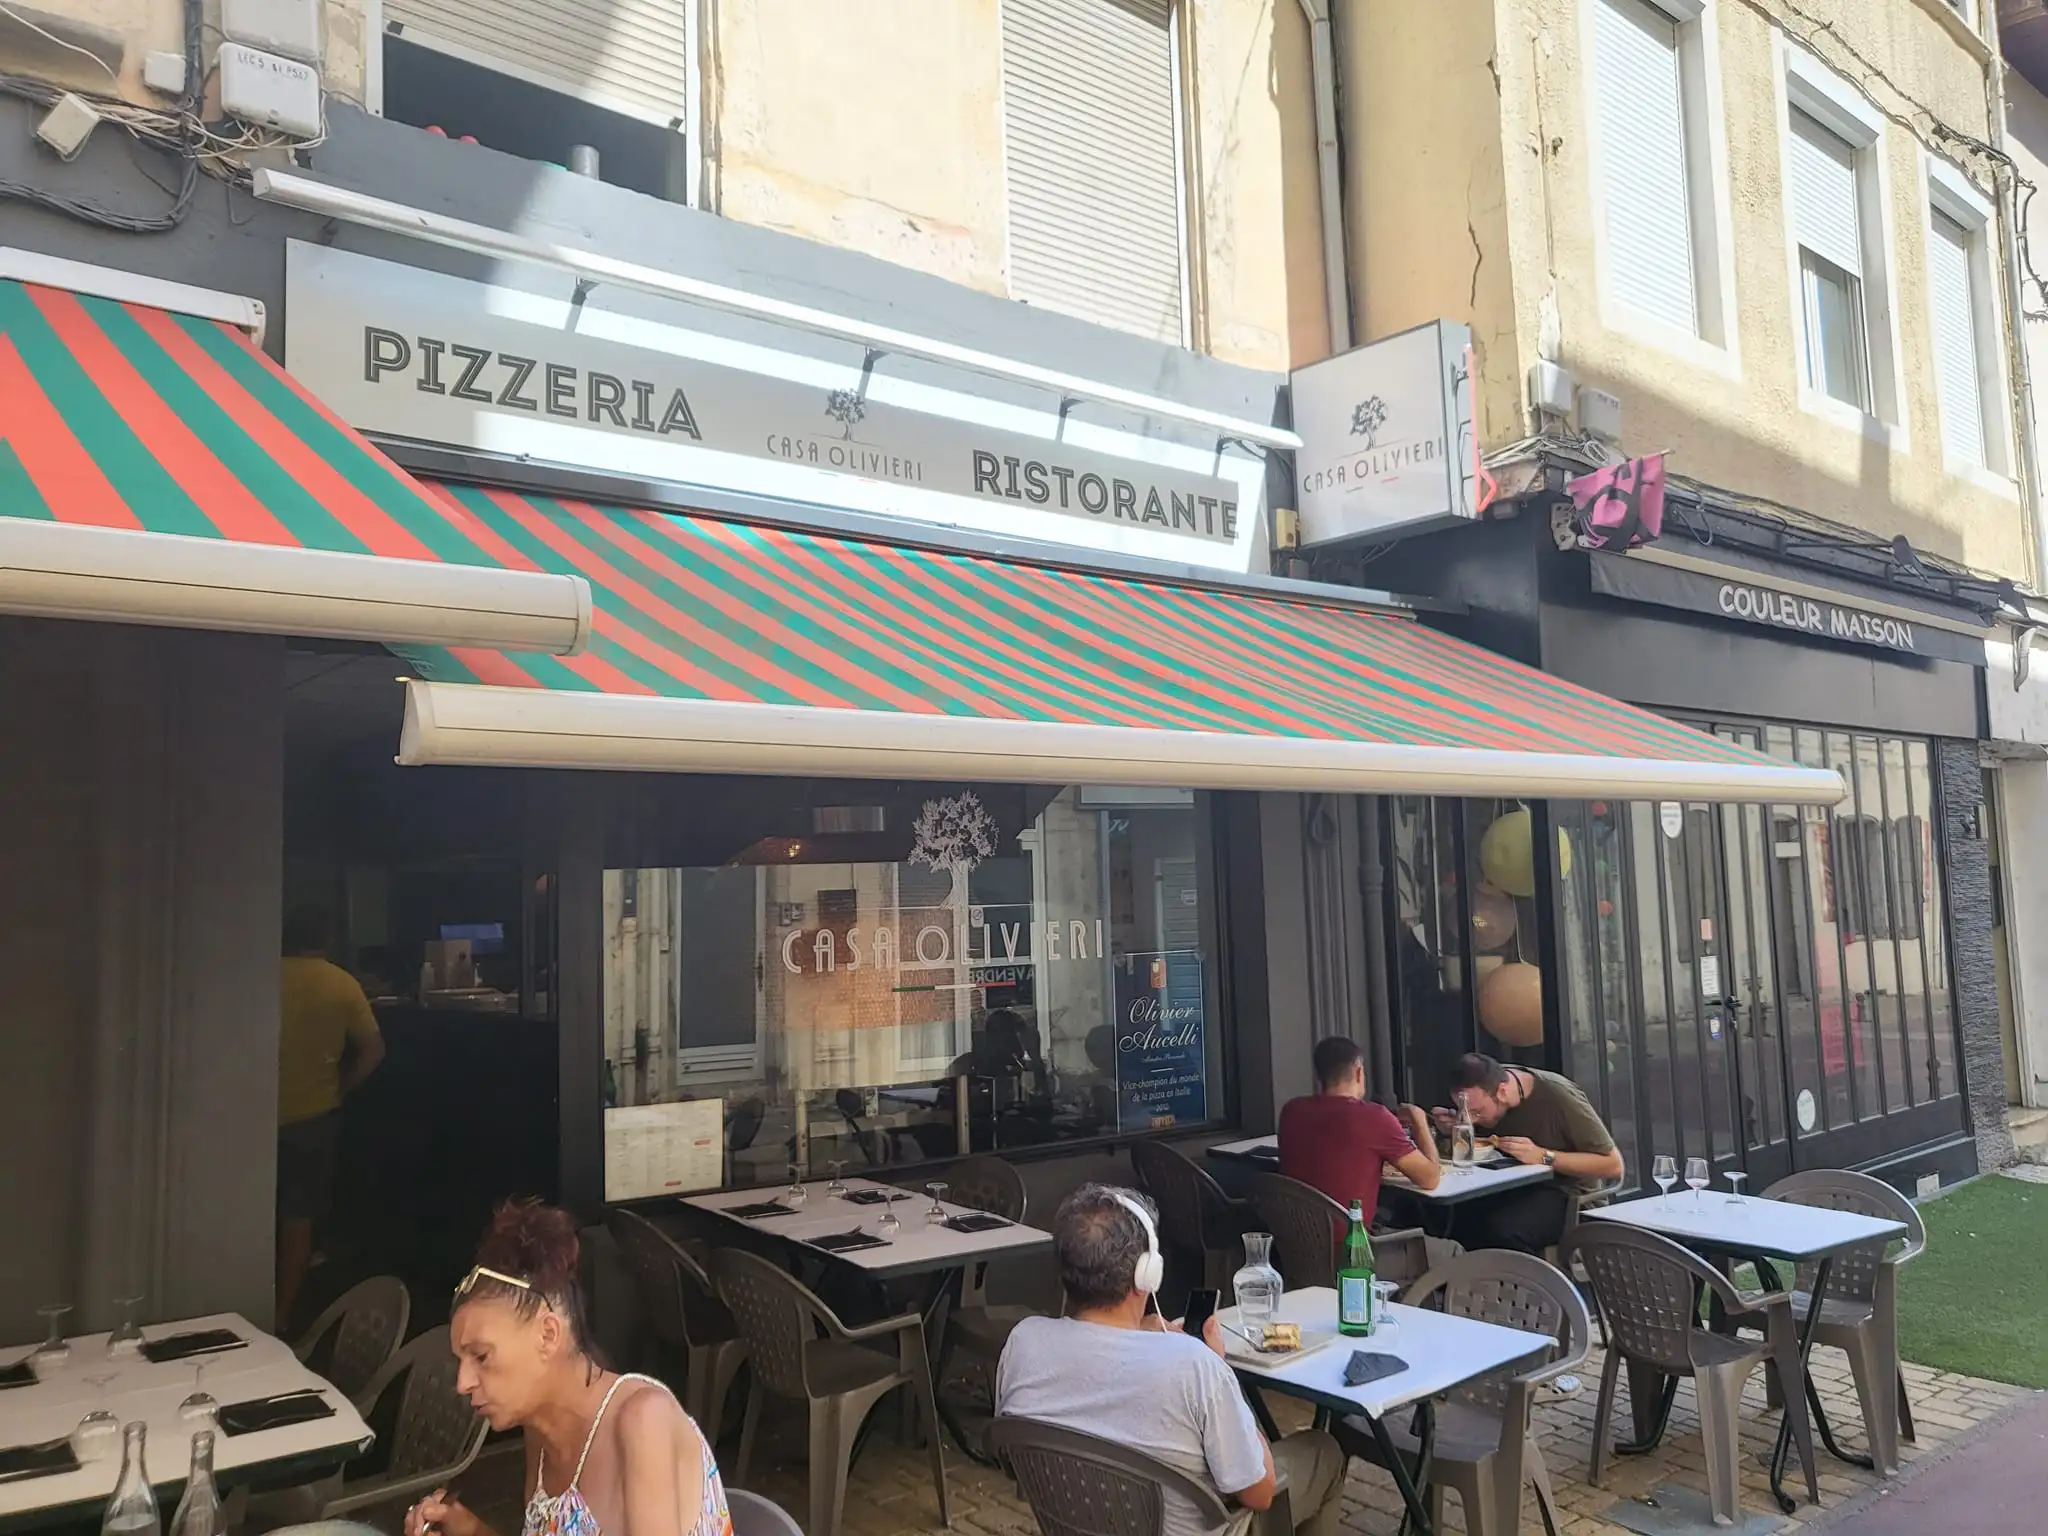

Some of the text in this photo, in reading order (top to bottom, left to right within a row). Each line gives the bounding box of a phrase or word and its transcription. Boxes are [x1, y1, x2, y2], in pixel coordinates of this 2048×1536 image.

[364, 325, 703, 441] PIZZERIA
[767, 434, 922, 481] CASA OLIVIERI
[1303, 436, 1443, 493] CASA OLIVIERI
[972, 449, 1239, 539] RISTORANTE
[1718, 584, 1915, 650] COULEUR MAISON
[782, 925, 893, 974] CASA
[1128, 996, 1196, 1024] Olivier
[1119, 1023, 1200, 1053] Aucelli
